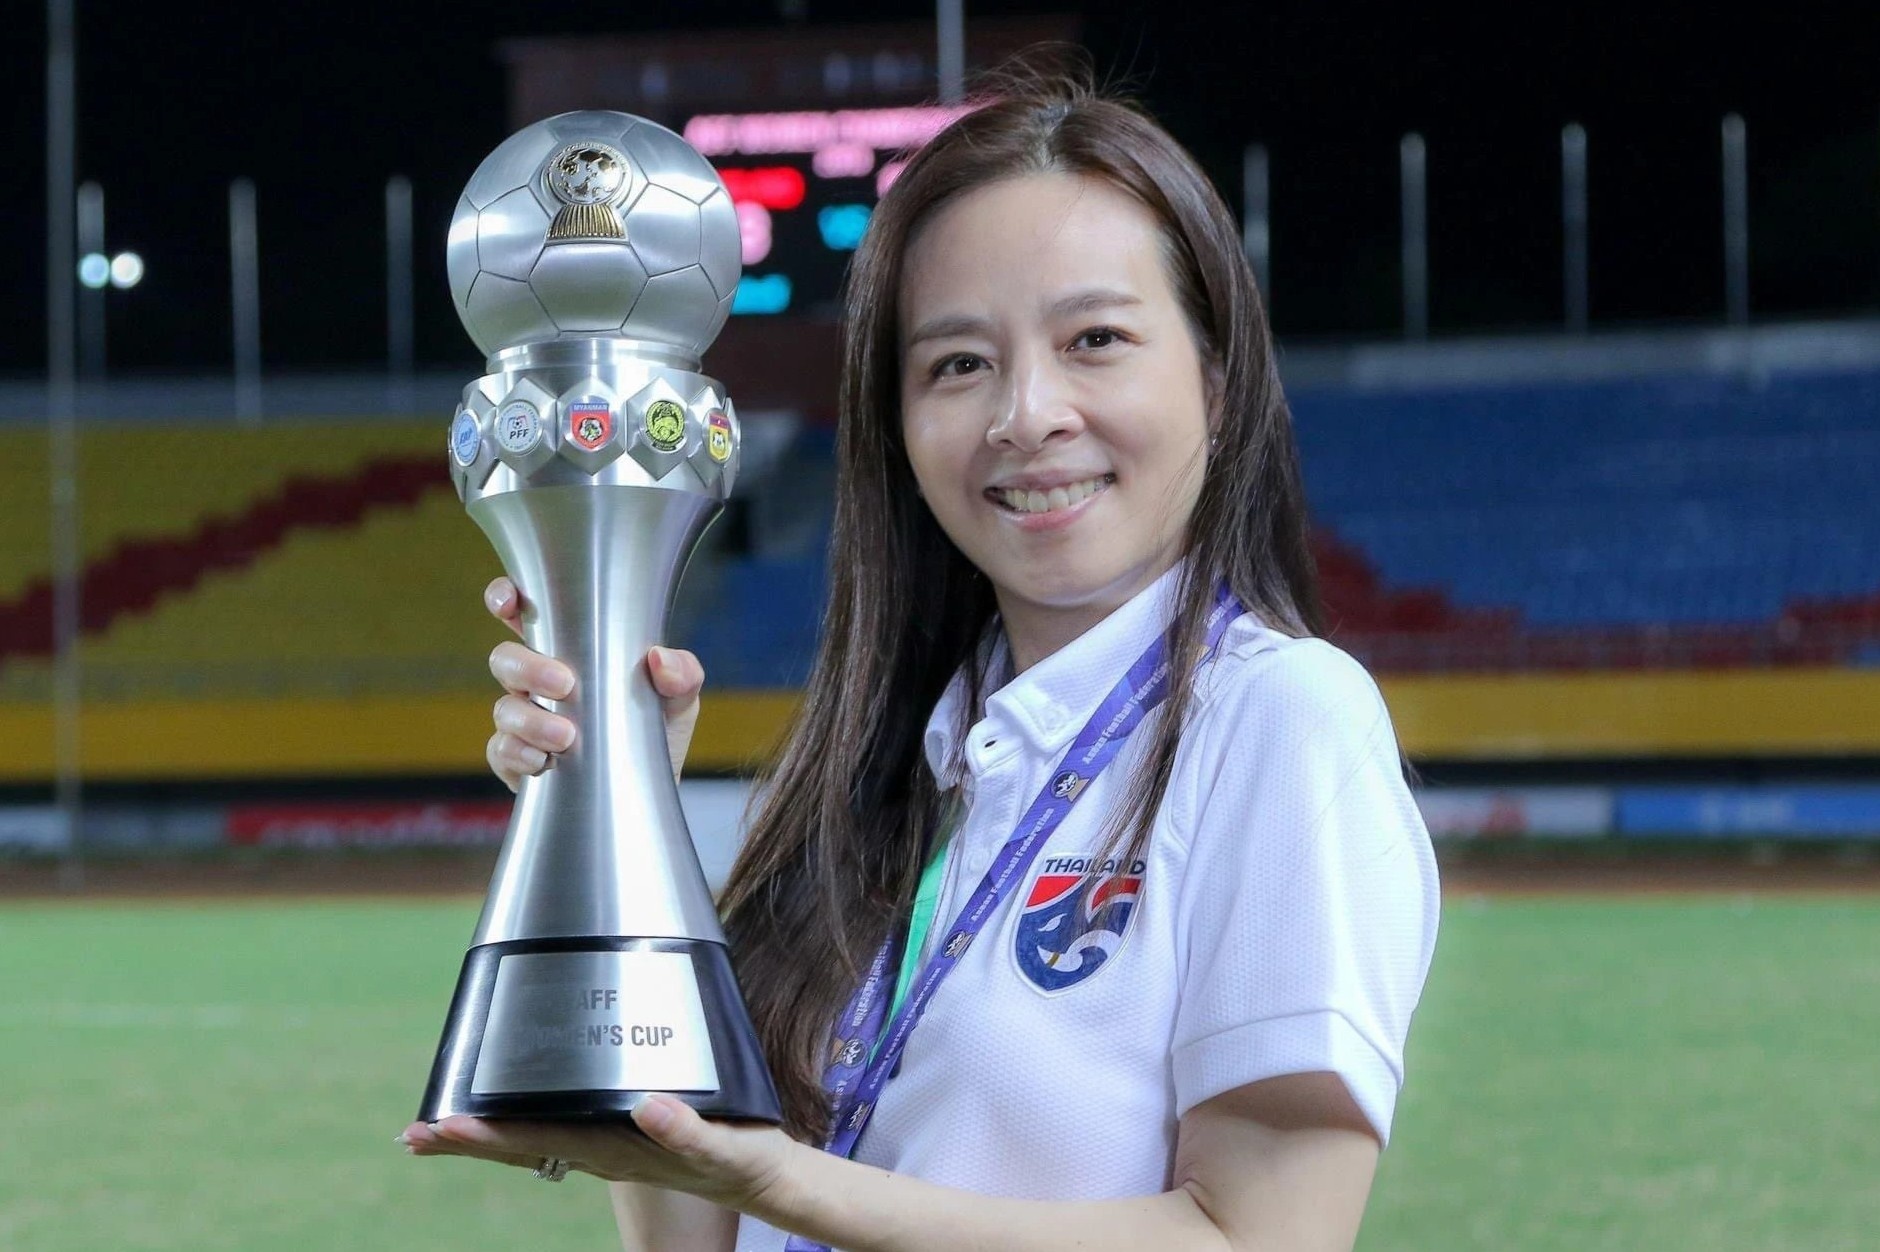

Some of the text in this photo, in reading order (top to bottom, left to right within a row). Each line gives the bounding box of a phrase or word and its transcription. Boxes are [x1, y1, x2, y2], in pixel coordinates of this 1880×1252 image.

[509, 428, 529, 440] PFF
[1101, 696, 1136, 738] Football
[990, 856, 1021, 894] Football
[1015, 808, 1055, 857] Federation
[576, 989, 618, 1010] AFF
[884, 1018, 910, 1059] Football
[906, 967, 942, 1019] Federation
[631, 1026, 674, 1047] CUP
